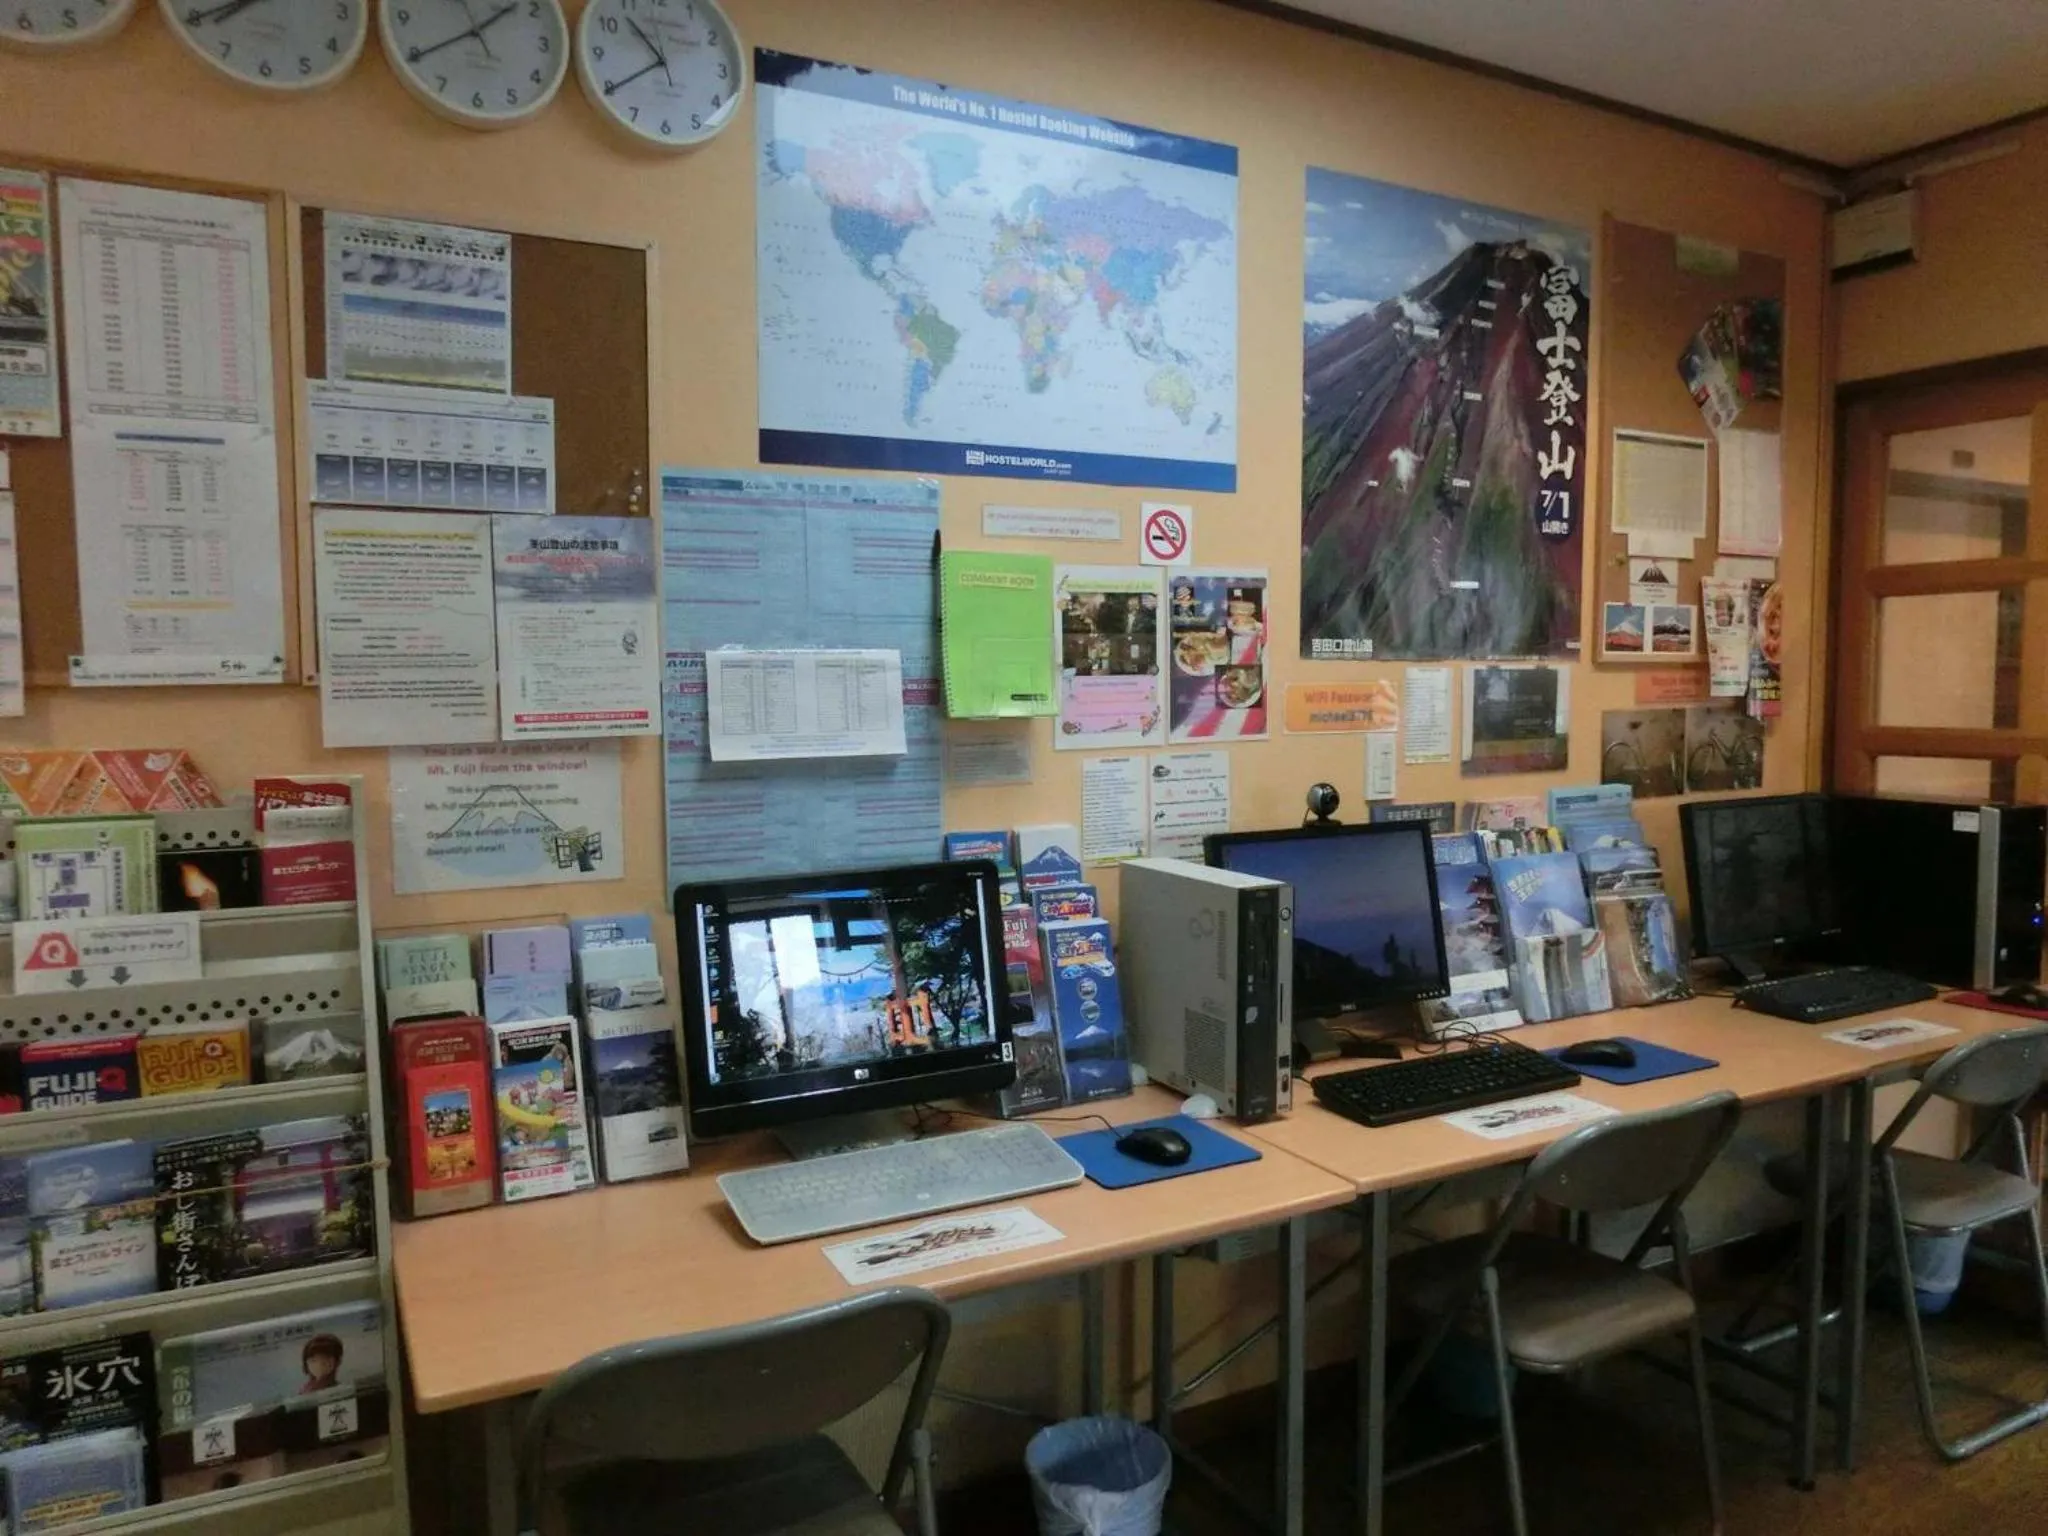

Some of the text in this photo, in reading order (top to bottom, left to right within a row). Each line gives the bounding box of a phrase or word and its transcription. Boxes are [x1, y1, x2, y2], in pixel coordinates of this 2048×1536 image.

[893, 85, 916, 104] The
[918, 90, 967, 115] World's
[969, 101, 989, 119] No.
[998, 107, 1038, 128] Hostel
[1039, 113, 1087, 139] Booking
[1536, 248, 1582, 480] 富士登山
[1541, 489, 1570, 519] 7/1
[453, 763, 476, 777] Fuji
[480, 761, 509, 773] from
[512, 761, 533, 772] the
[1004, 918, 1029, 932] Fuji
[149, 1056, 240, 1086] GUIDE
[46, 1355, 144, 1401] 氷穴
